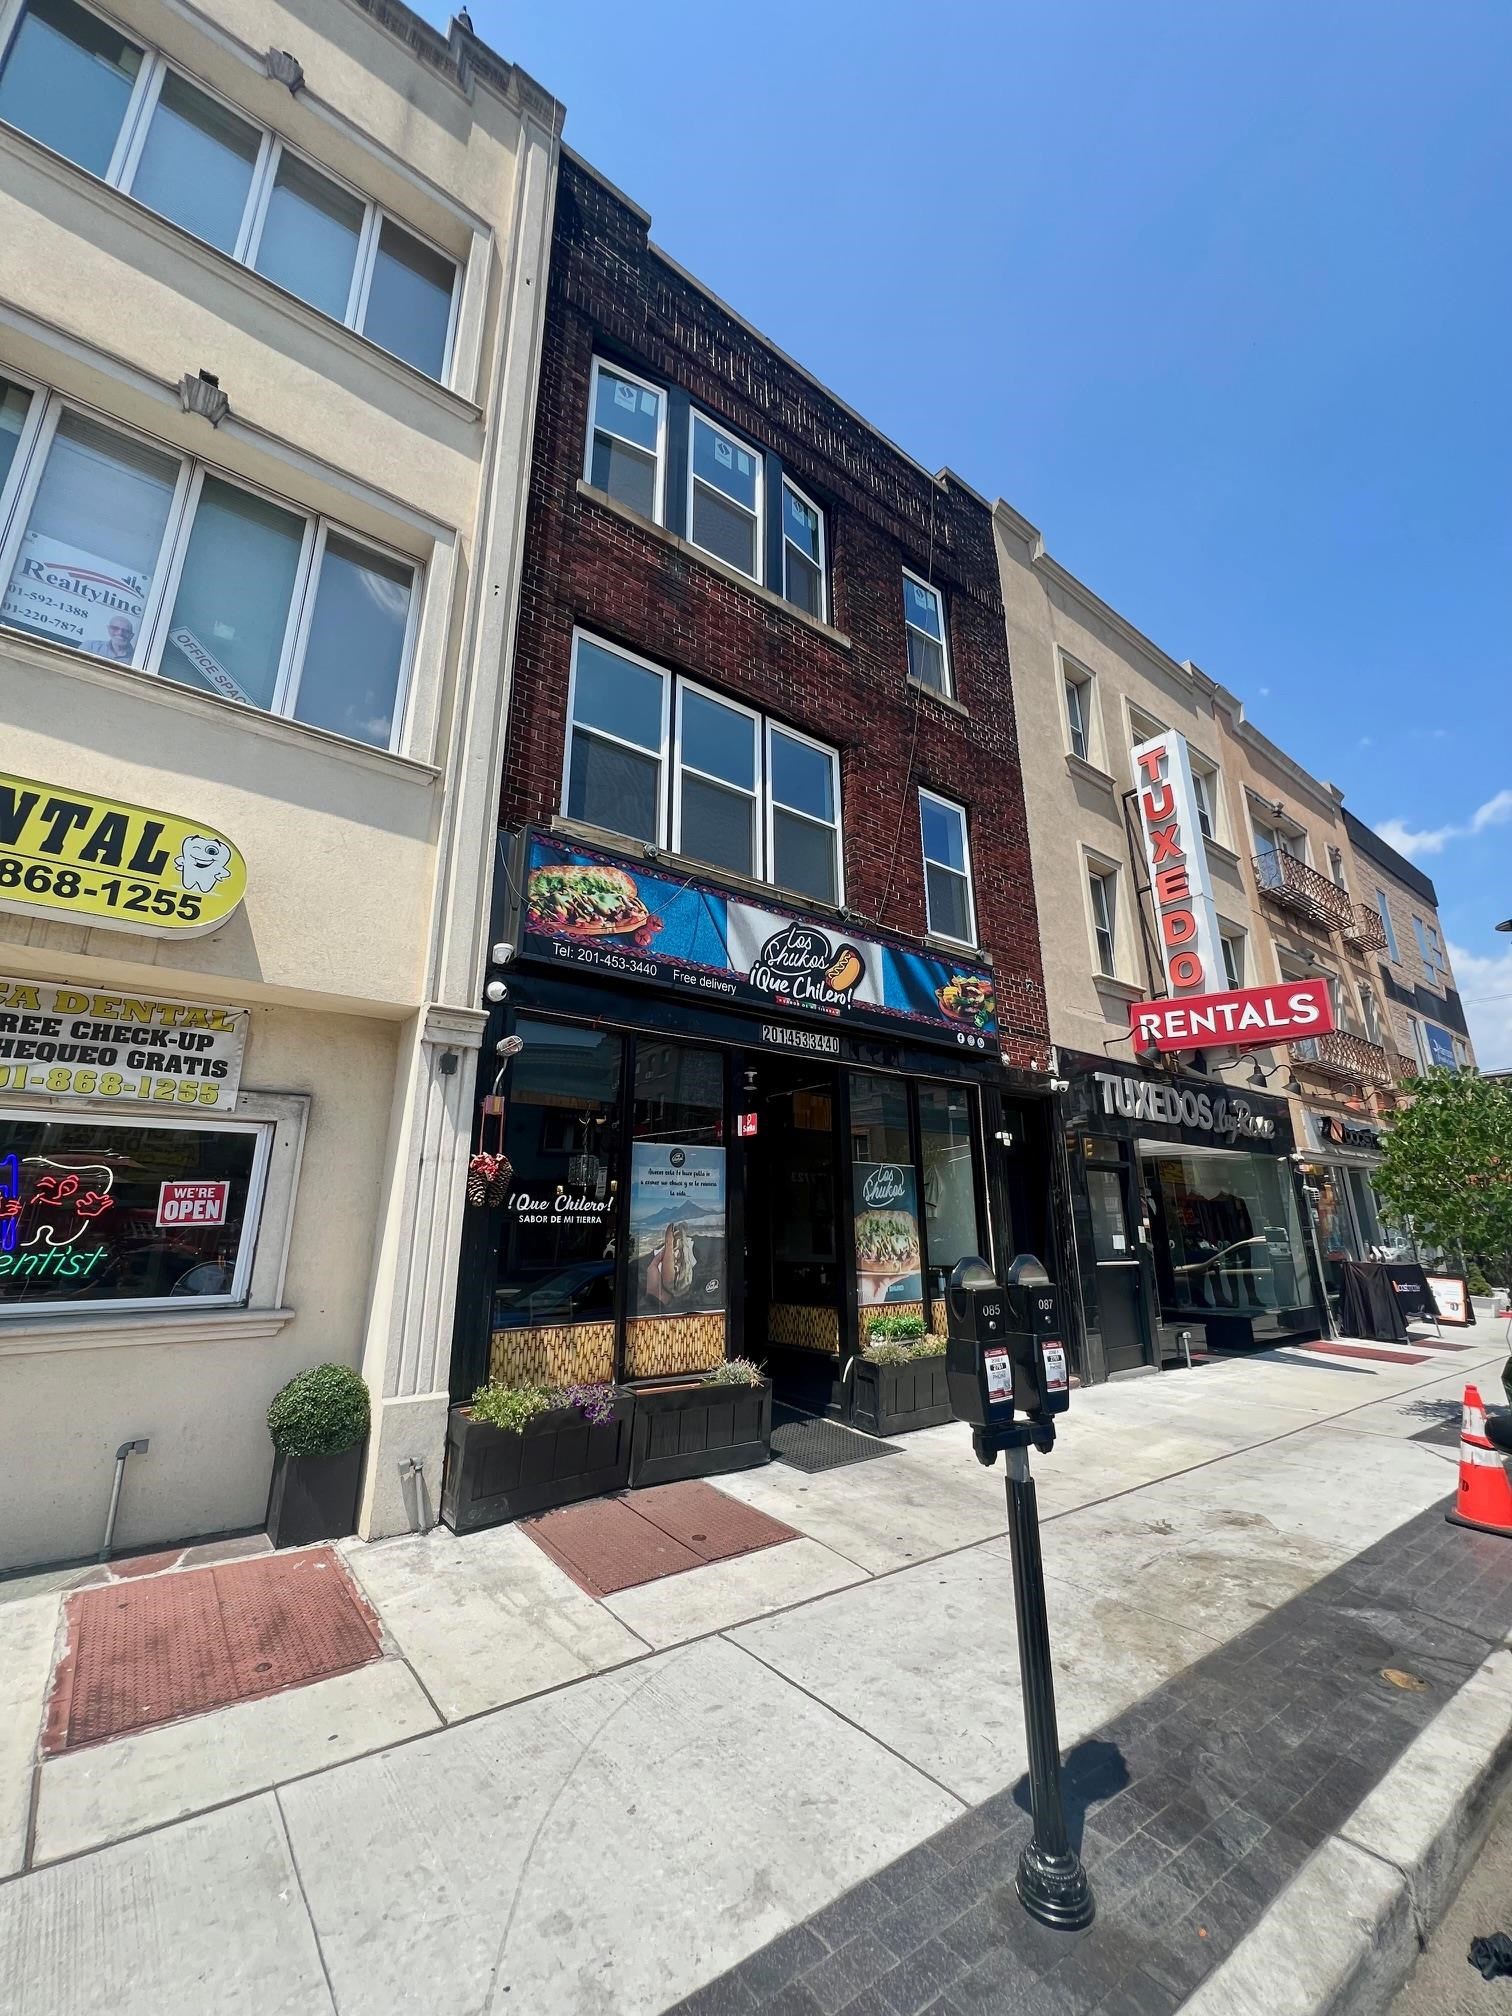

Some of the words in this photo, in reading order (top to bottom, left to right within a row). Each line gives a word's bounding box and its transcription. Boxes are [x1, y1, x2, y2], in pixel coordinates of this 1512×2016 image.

[23, 557, 142, 616] Realtyline
[177, 635, 218, 675] OFFICE
[1137, 745, 1205, 988] TUXEDO
[787, 927, 812, 950] Los
[553, 942, 574, 959] Tel:
[577, 947, 658, 977] 201-453-3440
[767, 941, 829, 969] Shukos
[673, 969, 697, 985] Free
[699, 975, 737, 996] delivery
[750, 962, 790, 993] ¡Que
[793, 976, 853, 1010] Chilero!
[52, 989, 236, 1033] DENTAL
[1139, 993, 1320, 1041] RENTALS
[70, 1020, 215, 1053] CHECK-UP
[126, 1049, 229, 1079] GRATIS
[1094, 1071, 1214, 1131] TUXEDOS
[878, 1164, 894, 1182] Los
[173, 1187, 216, 1199] WE'RE
[554, 1194, 614, 1212] Chilero!
[865, 1178, 905, 1202] Shukos
[164, 1200, 221, 1221] OPEN
[518, 1215, 548, 1224] SABOR
[550, 1215, 562, 1224] DE
[563, 1215, 574, 1224] MI
[576, 1215, 602, 1224] TIERRA
[982, 1304, 1001, 1317] 085
[1038, 1299, 1054, 1311] 087
